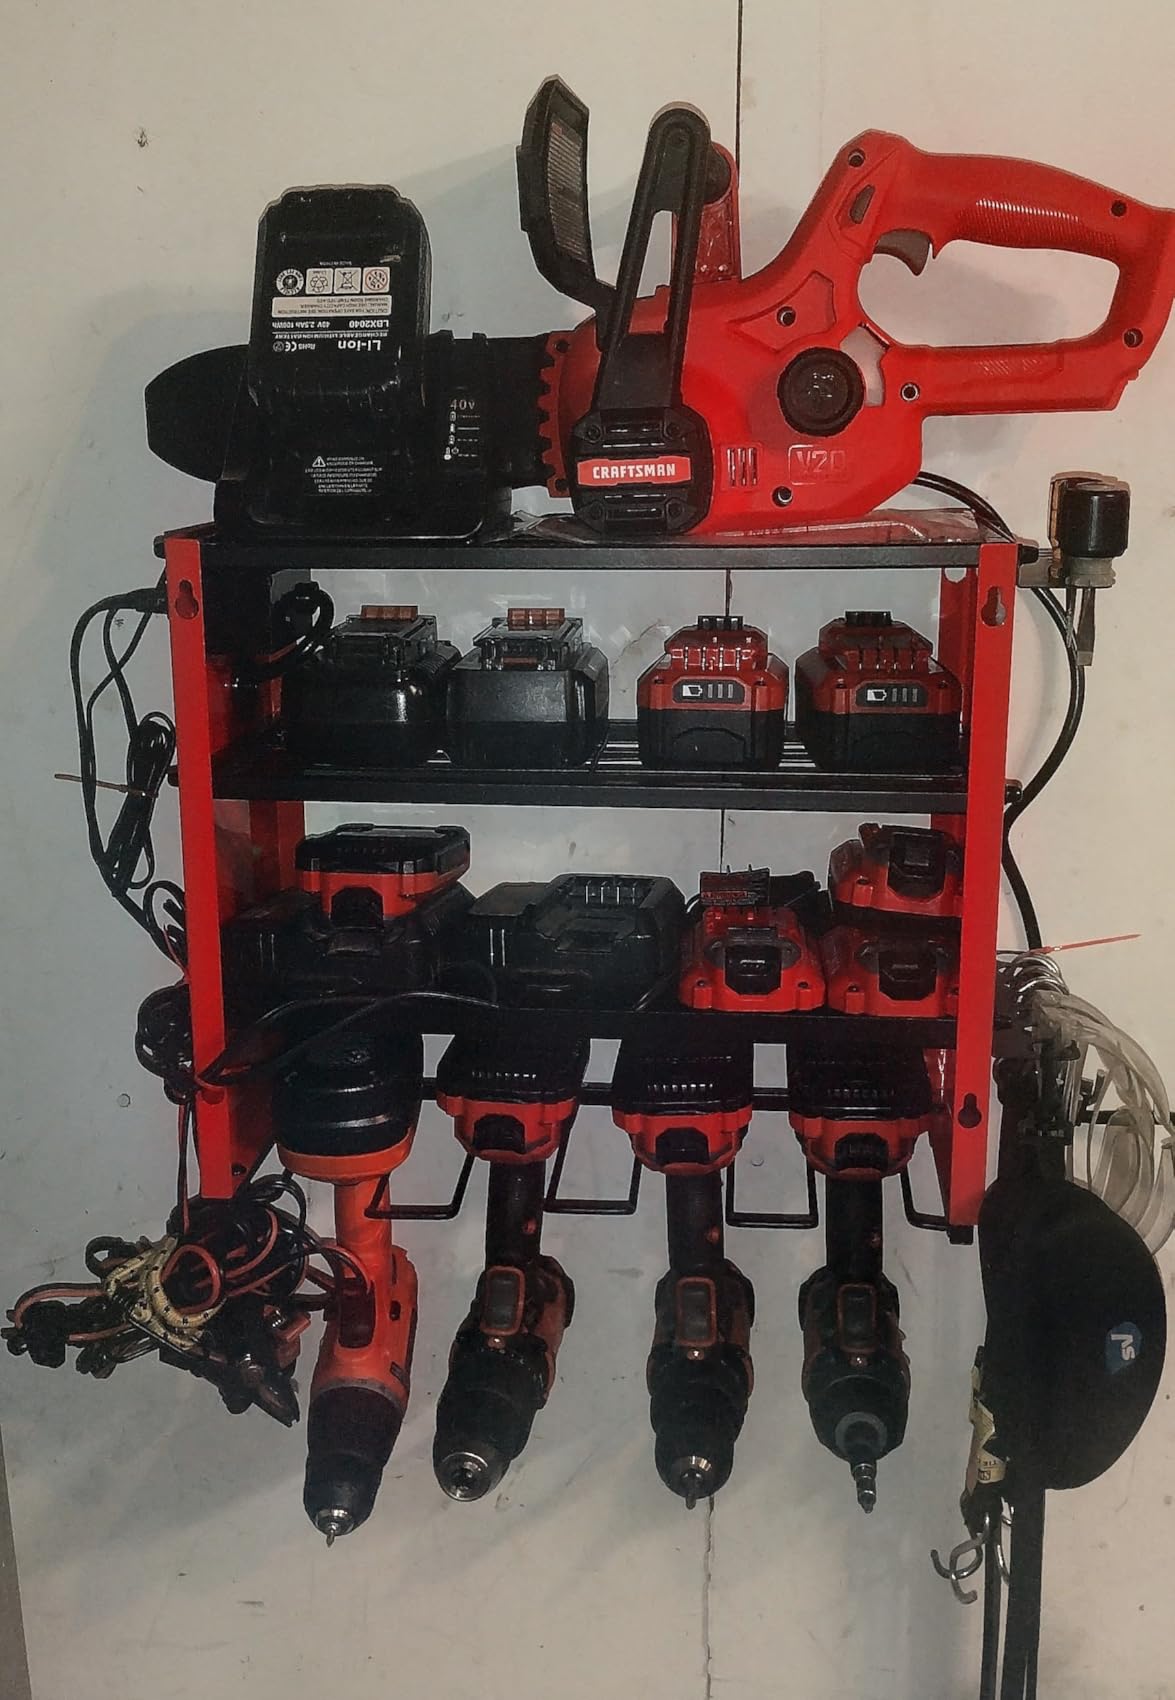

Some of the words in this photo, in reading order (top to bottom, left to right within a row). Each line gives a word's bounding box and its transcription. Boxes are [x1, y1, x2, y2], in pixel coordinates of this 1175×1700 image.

[349, 319, 389, 328] LBX2040
[795, 450, 846, 474] V20
[592, 463, 676, 479] CRAFTSMAN
